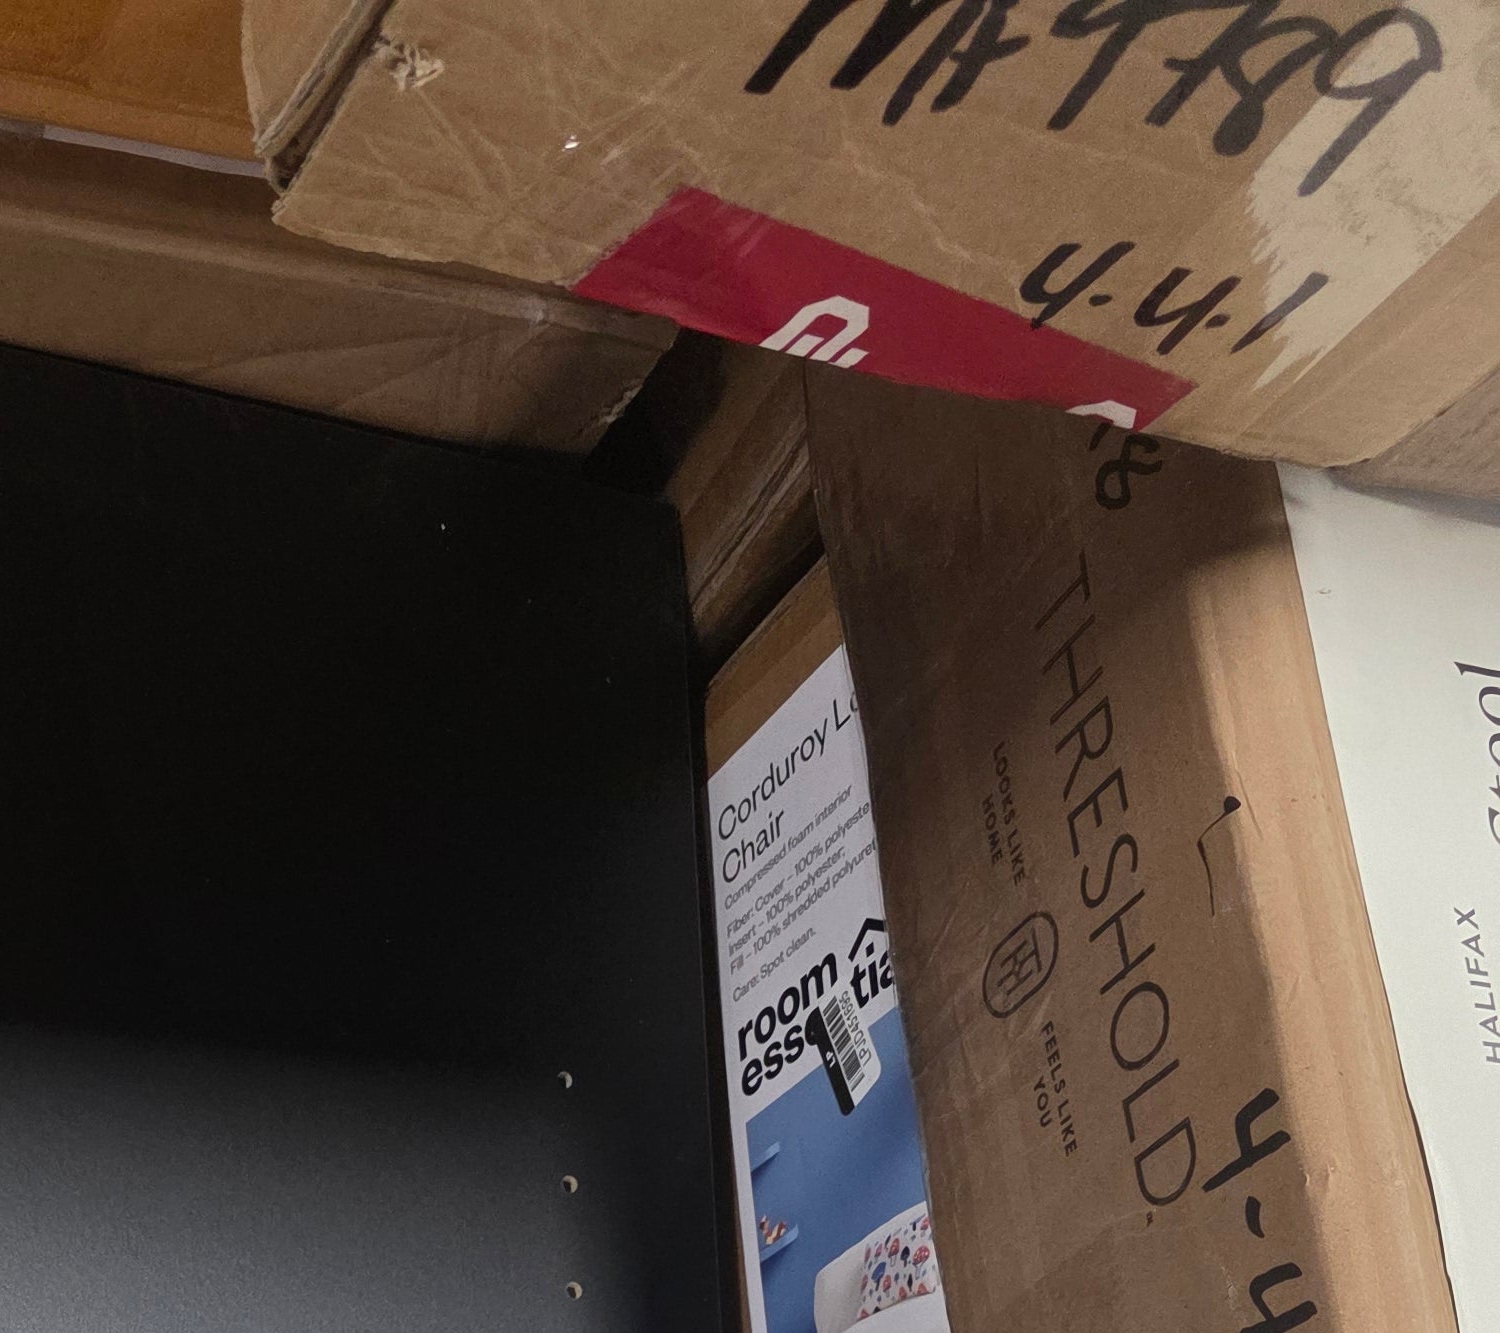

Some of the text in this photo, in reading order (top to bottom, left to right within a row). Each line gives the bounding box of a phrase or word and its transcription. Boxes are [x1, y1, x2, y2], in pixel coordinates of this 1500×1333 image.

[718, 718, 828, 840] Corduroy
[993, 743, 1027, 886] LOOKS LIKE
[722, 808, 784, 883] Chair
[724, 785, 852, 910] Compressed foam interior
[981, 793, 1003, 866] HOME
[728, 926, 756, 957] Insert
[766, 891, 794, 923] 100%
[753, 925, 781, 955] 100%
[782, 876, 831, 931] shredded
[755, 878, 785, 912] Cover
[794, 843, 823, 876] 100%
[1034, 551, 1197, 1206] THRESHOLD
[732, 927, 817, 1002] Care: Spot clean.
[737, 952, 838, 1063] room
[1454, 906, 1500, 1065] HALIFAX
[1032, 1076, 1052, 1129] YOU
[1041, 1020, 1078, 1157] FEELS LIKE
